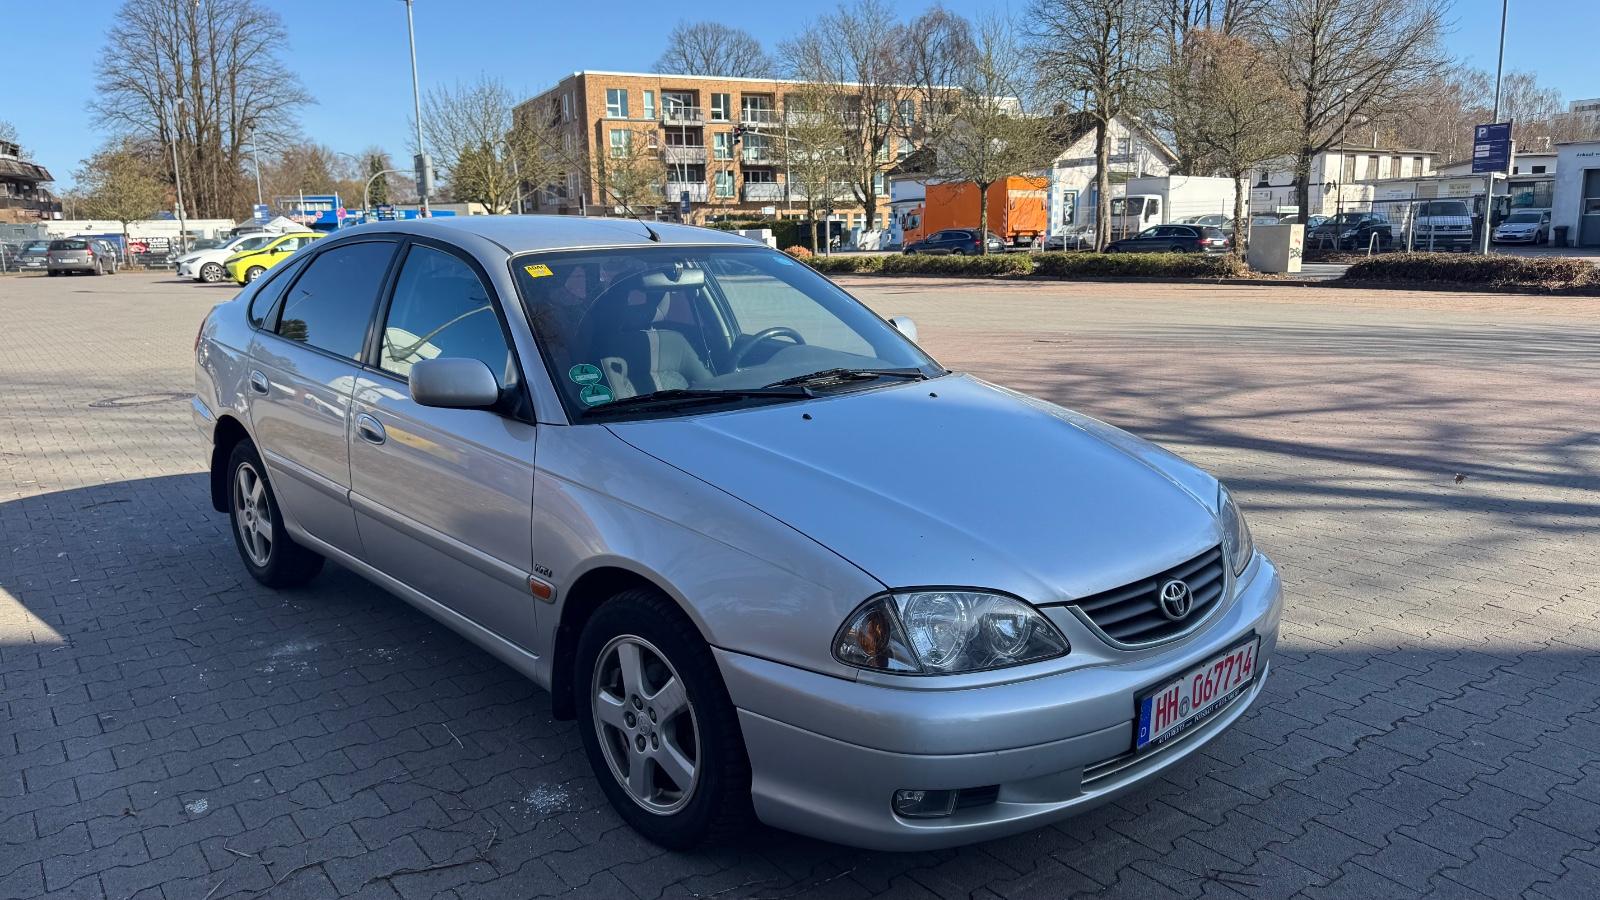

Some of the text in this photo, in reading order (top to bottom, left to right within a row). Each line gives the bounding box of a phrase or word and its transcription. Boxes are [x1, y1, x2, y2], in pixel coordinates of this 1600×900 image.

[1479, 128, 1486, 137] P
[1155, 687, 1179, 733] HH
[1193, 646, 1252, 708] 067714
[1140, 727, 1146, 738] D
